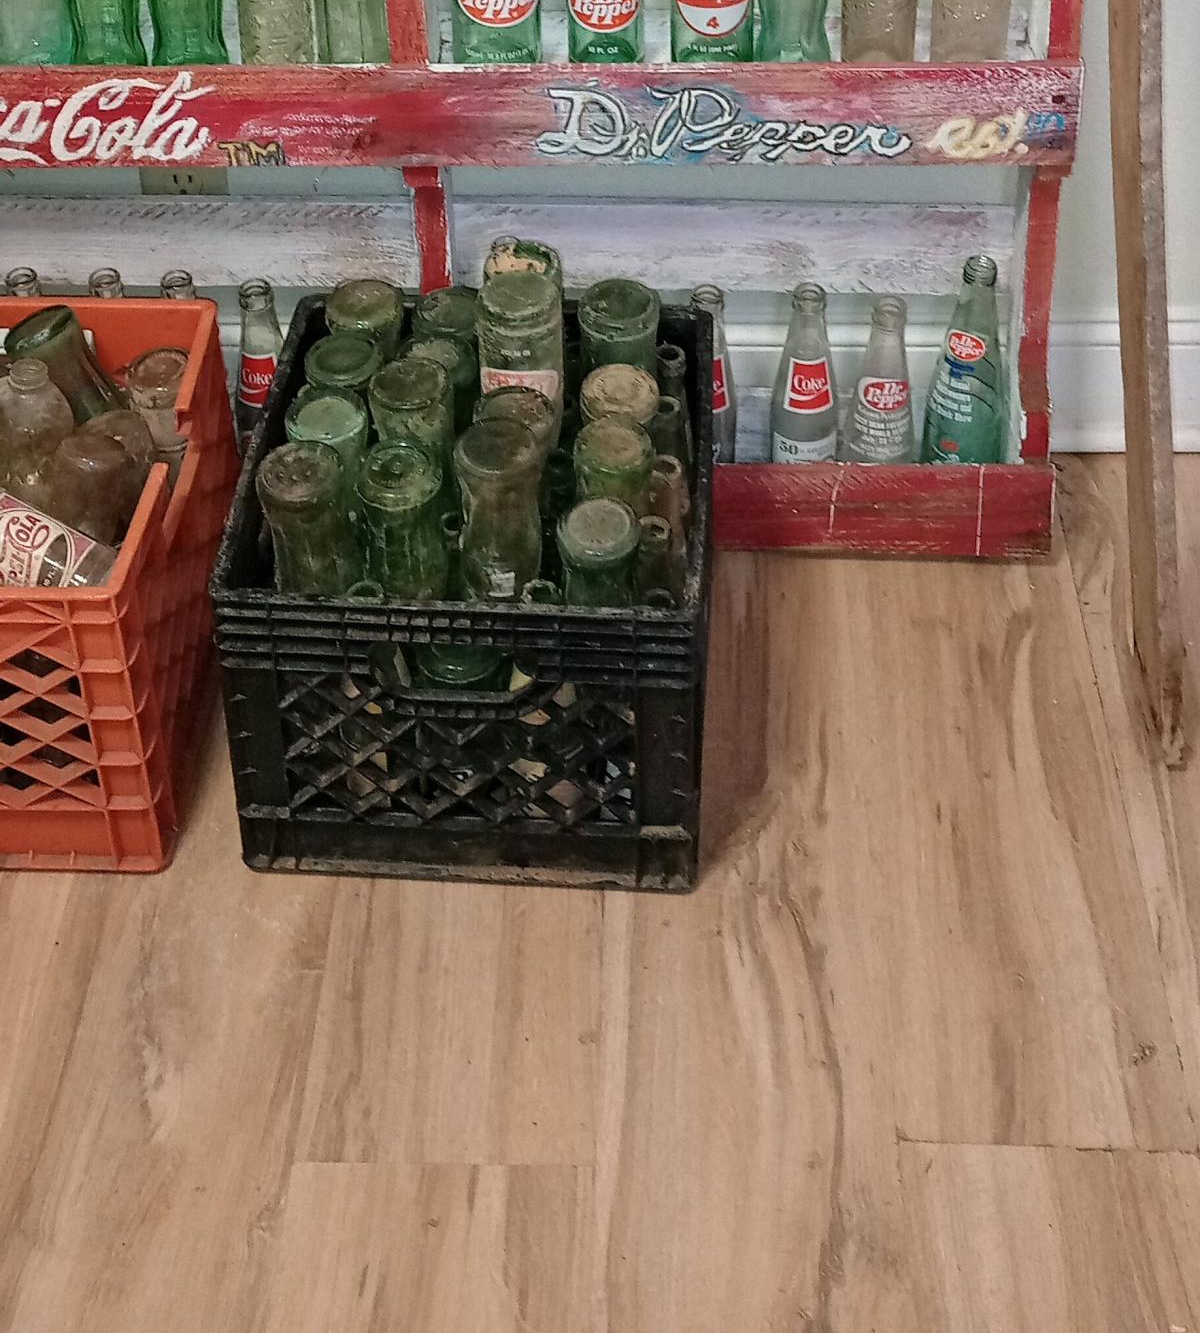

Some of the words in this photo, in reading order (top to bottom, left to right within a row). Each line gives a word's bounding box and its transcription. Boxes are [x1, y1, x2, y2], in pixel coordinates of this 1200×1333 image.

[706, 16, 720, 29] 4
[0, 71, 217, 162] a-Cola
[217, 141, 286, 166] TM
[645, 82, 913, 164] Pepper
[243, 368, 273, 386] Coke
[793, 374, 826, 393] Coke
